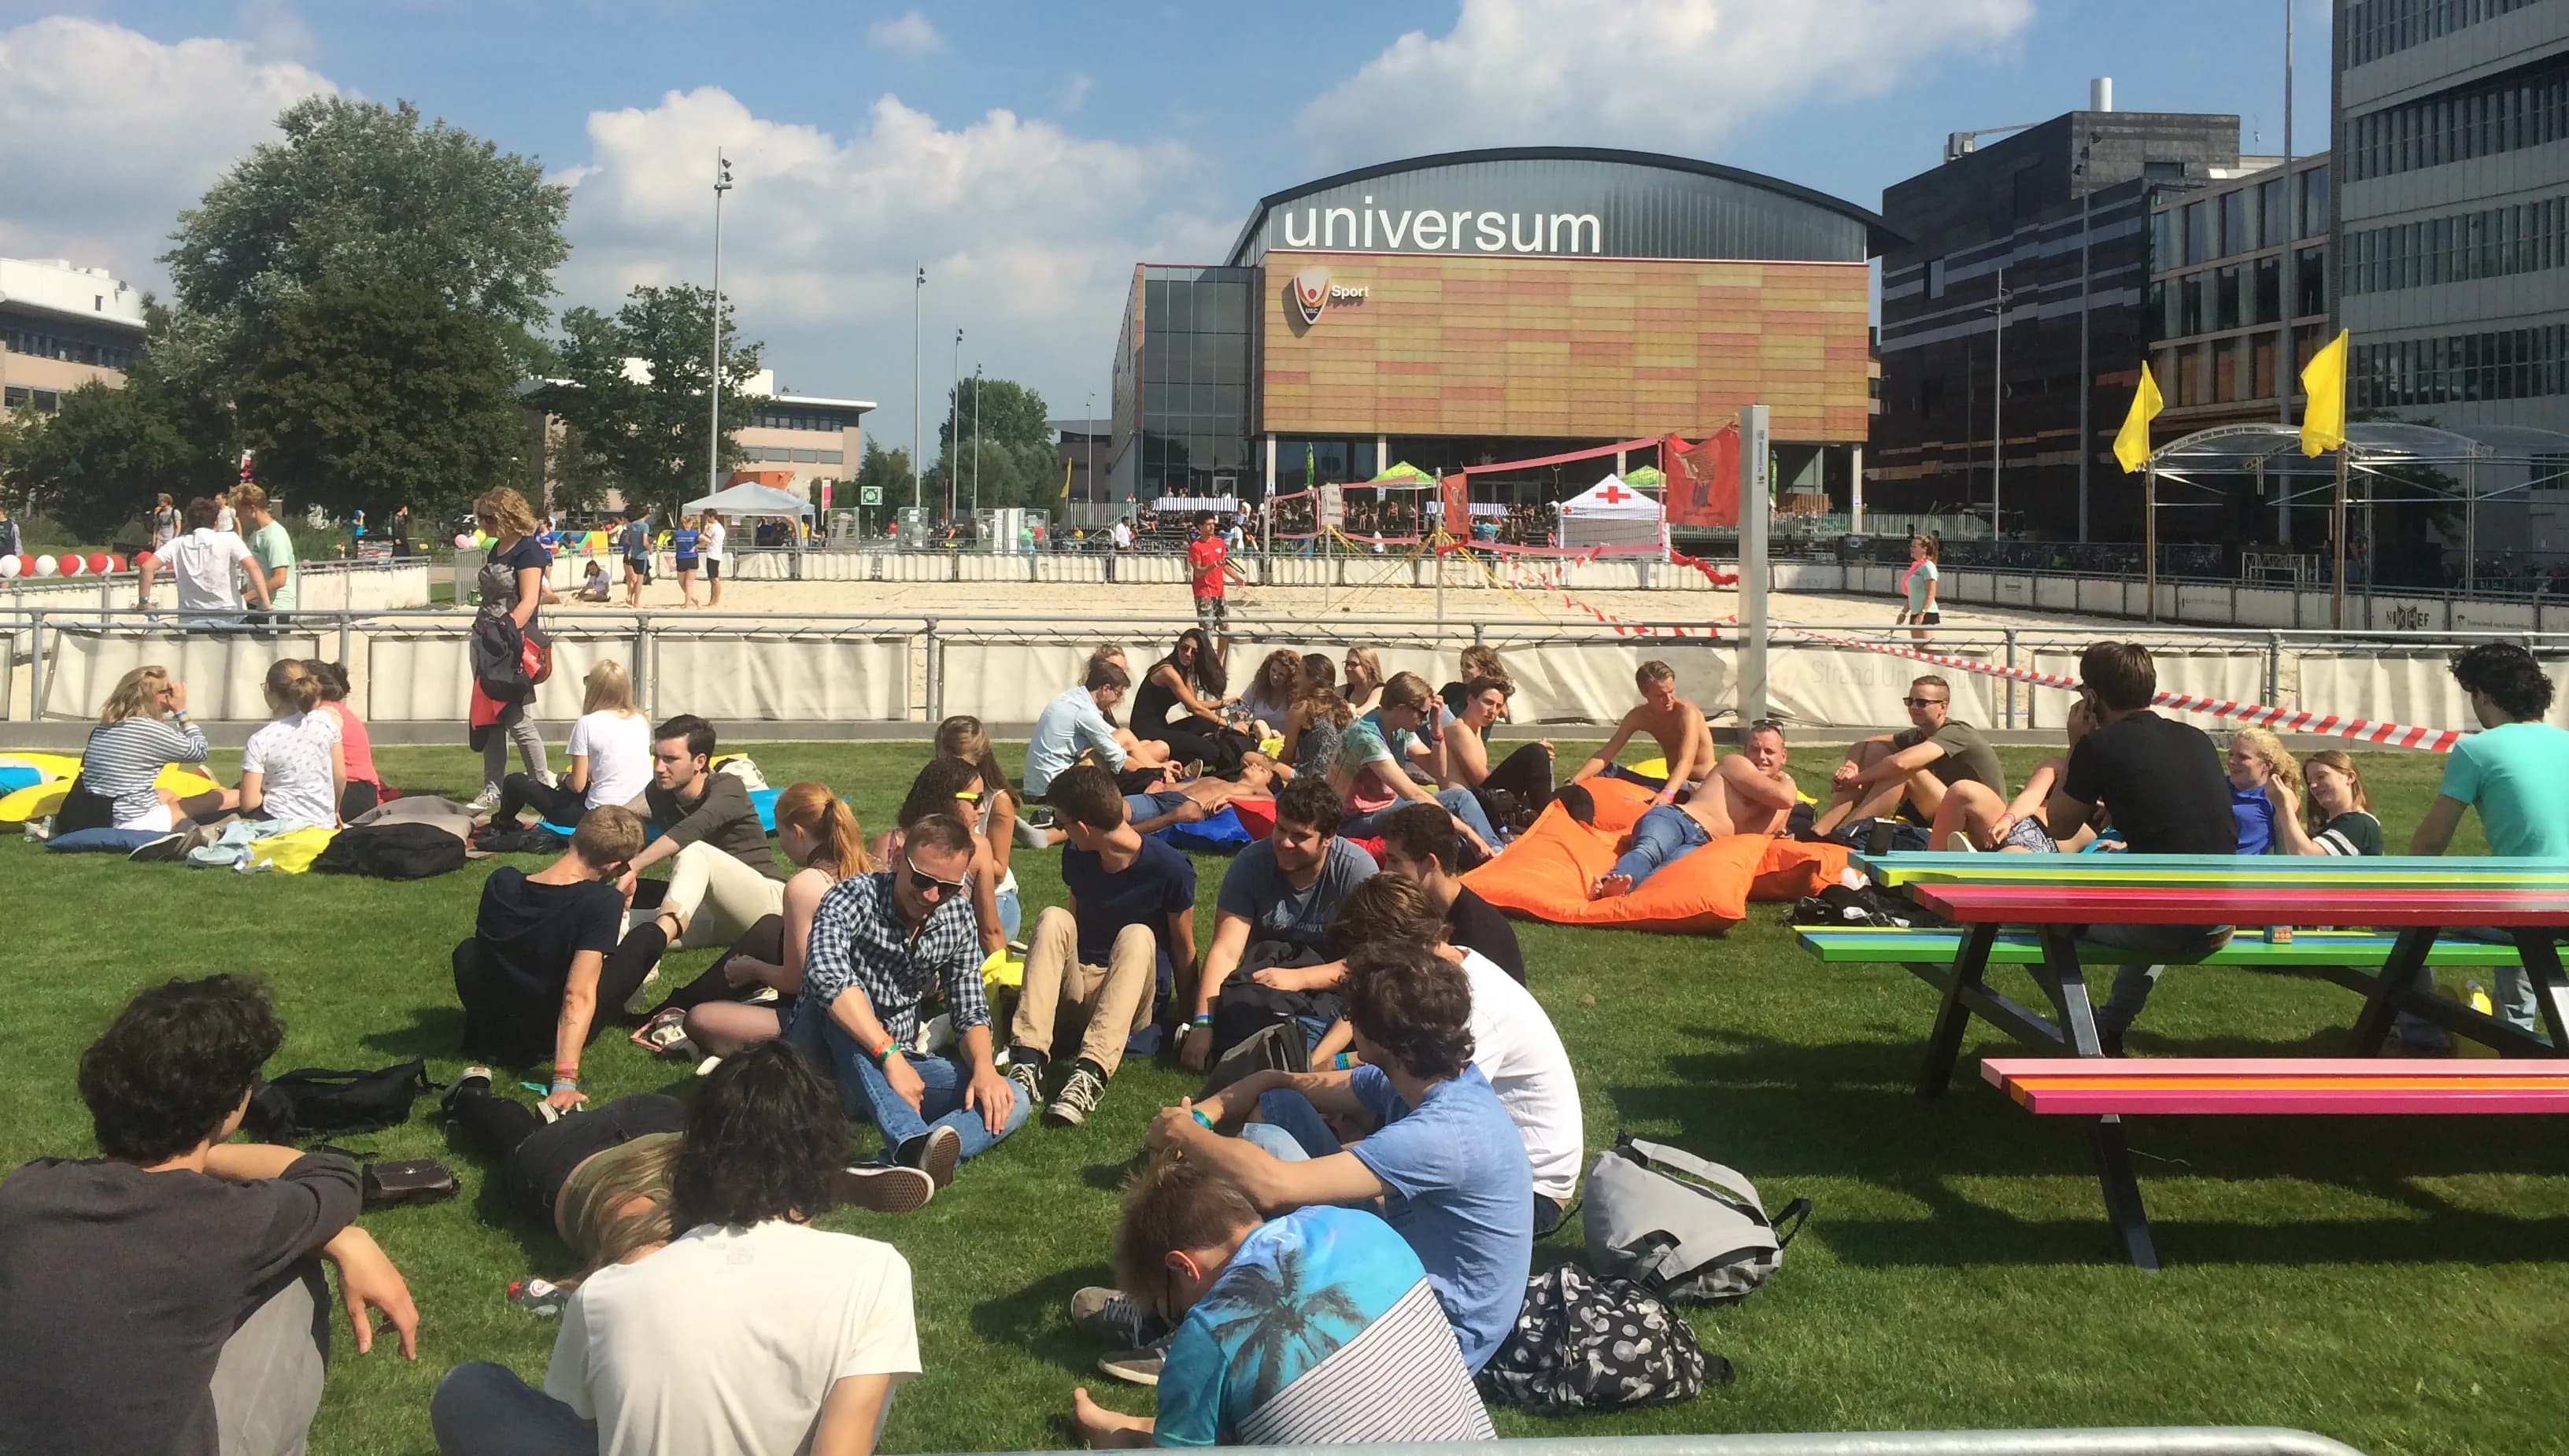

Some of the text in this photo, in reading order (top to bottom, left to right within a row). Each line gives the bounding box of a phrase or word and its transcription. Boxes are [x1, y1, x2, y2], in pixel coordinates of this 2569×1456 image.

[1284, 195, 1601, 253] universum
[1331, 285, 1370, 300] Sport
[2386, 608, 2430, 628] NIKHEF
[1811, 659, 1986, 690] Strand Unisum
